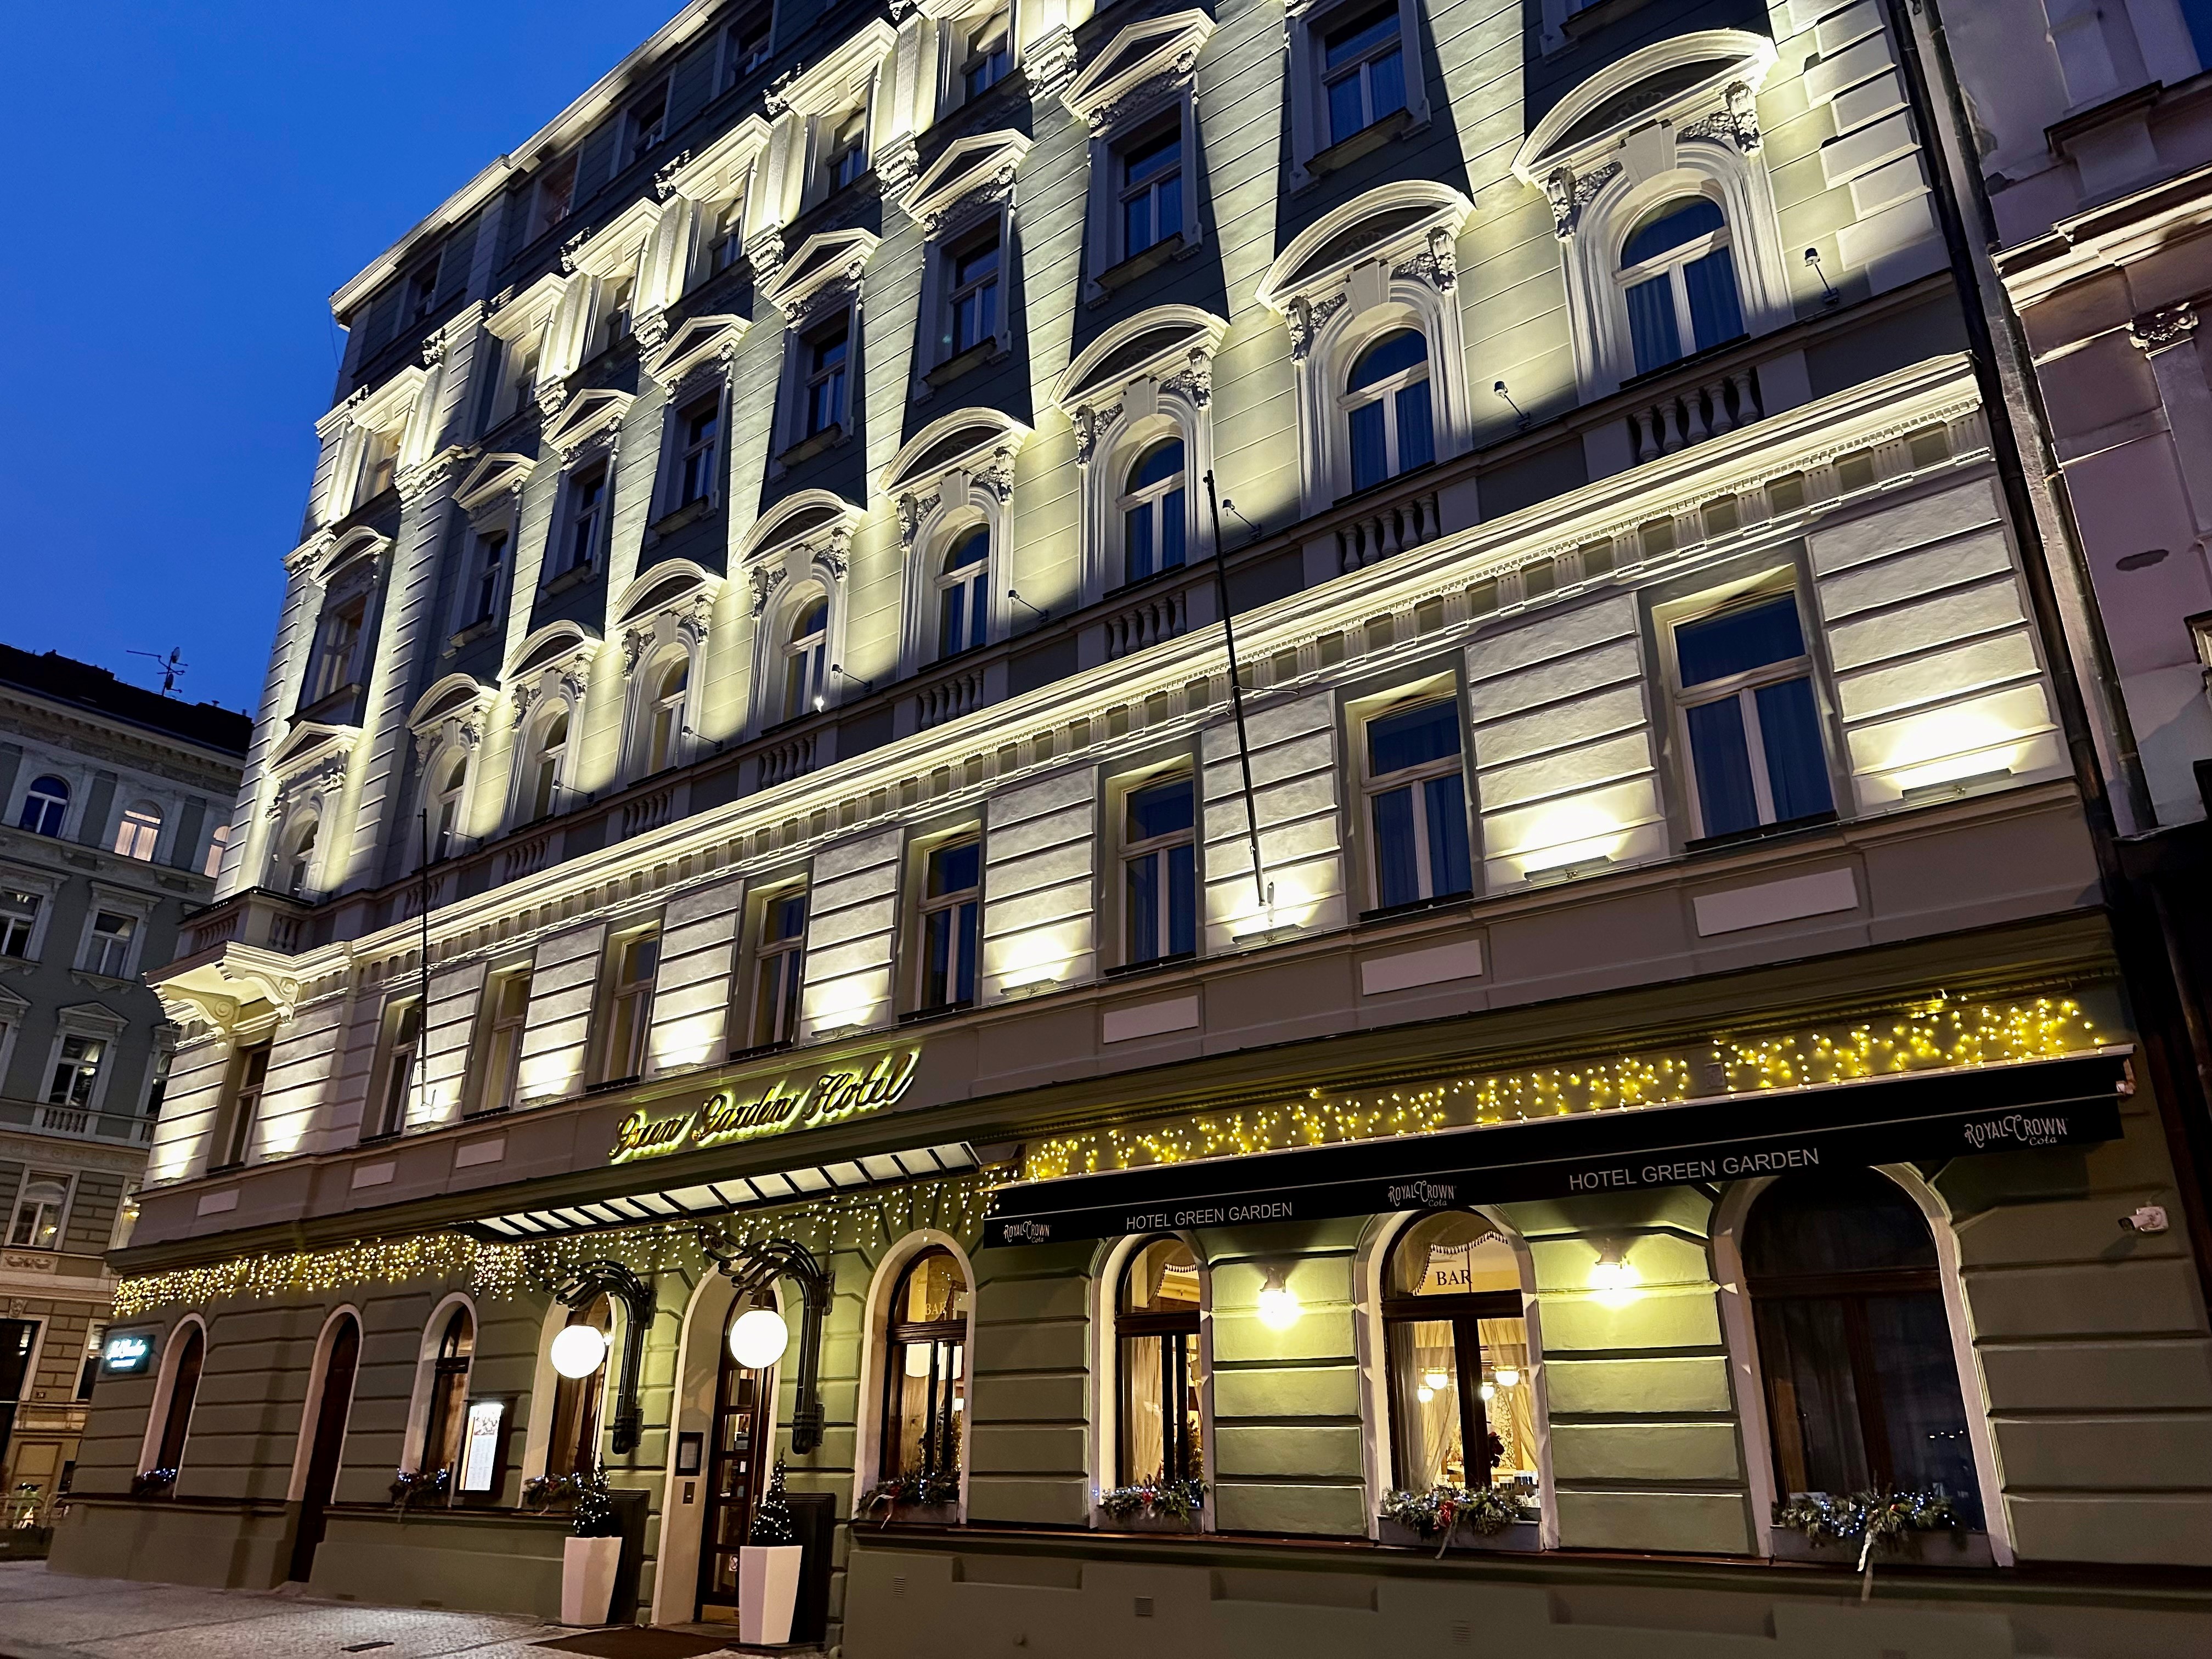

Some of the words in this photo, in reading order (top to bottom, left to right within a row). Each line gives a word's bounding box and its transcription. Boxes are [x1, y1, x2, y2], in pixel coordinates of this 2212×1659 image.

[608, 1111, 693, 1160] Green
[691, 1084, 805, 1143] Garden
[802, 1052, 916, 1121] Hotel
[1964, 1120, 2008, 1148] ROYAL
[2003, 1114, 2067, 1141] CROWN
[2029, 1135, 2057, 1146] Cola
[1570, 1169, 1637, 1190] HOTEL
[1642, 1160, 1716, 1182] GREEN
[1723, 1148, 1819, 1174] GARDEN
[1388, 1184, 1417, 1206] ROYAL
[1414, 1181, 1454, 1202] CROWN
[1126, 1211, 1171, 1230] HOTEL
[1175, 1208, 1224, 1226] GREEN
[1229, 1201, 1292, 1221] GARDEN
[1003, 1224, 1024, 1243] ROYAL
[1022, 1220, 1049, 1239] CROWN
[1436, 1269, 1472, 1286] BAR
[925, 1302, 947, 1316] BAR
